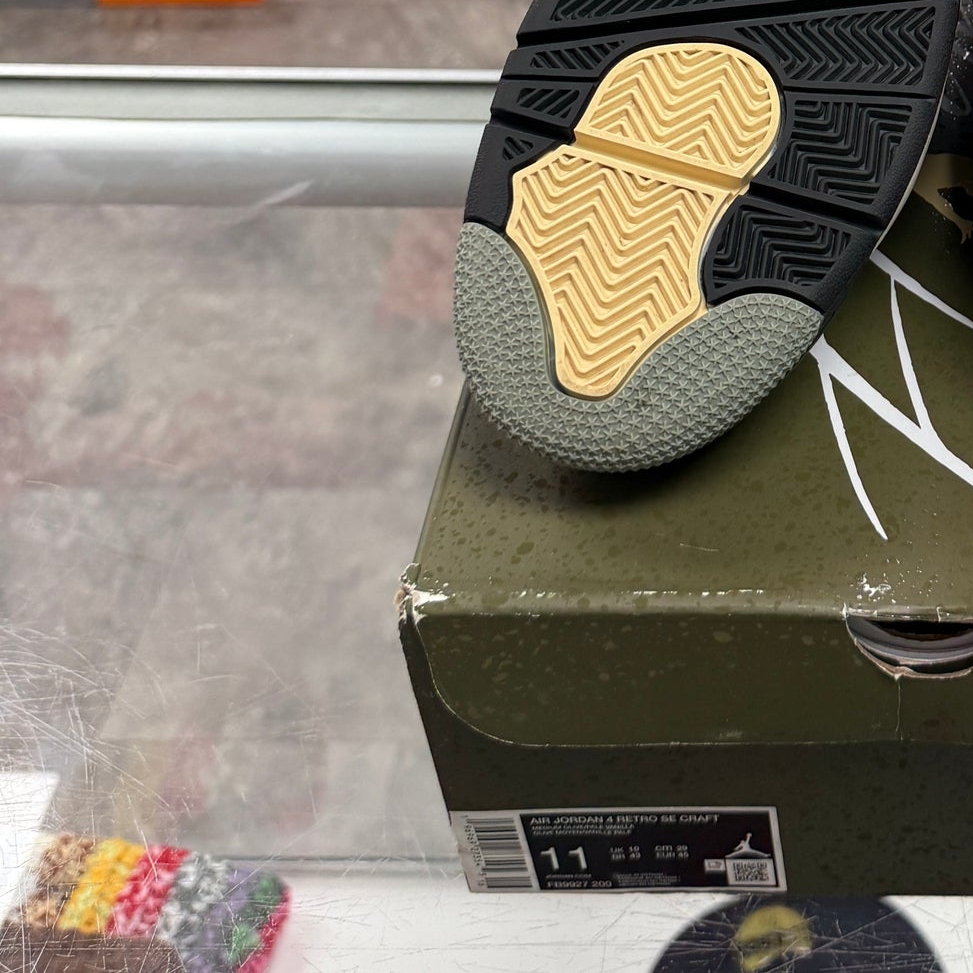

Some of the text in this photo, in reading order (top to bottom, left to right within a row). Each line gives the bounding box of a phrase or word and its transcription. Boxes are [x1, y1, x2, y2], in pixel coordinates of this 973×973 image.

[530, 814, 720, 825] AIR JORDAN 4 RETRO SE CRAFT
[610, 845, 640, 854] UK 10
[540, 846, 588, 871] 11
[676, 851, 689, 859] 45
[591, 880, 612, 888] 200
